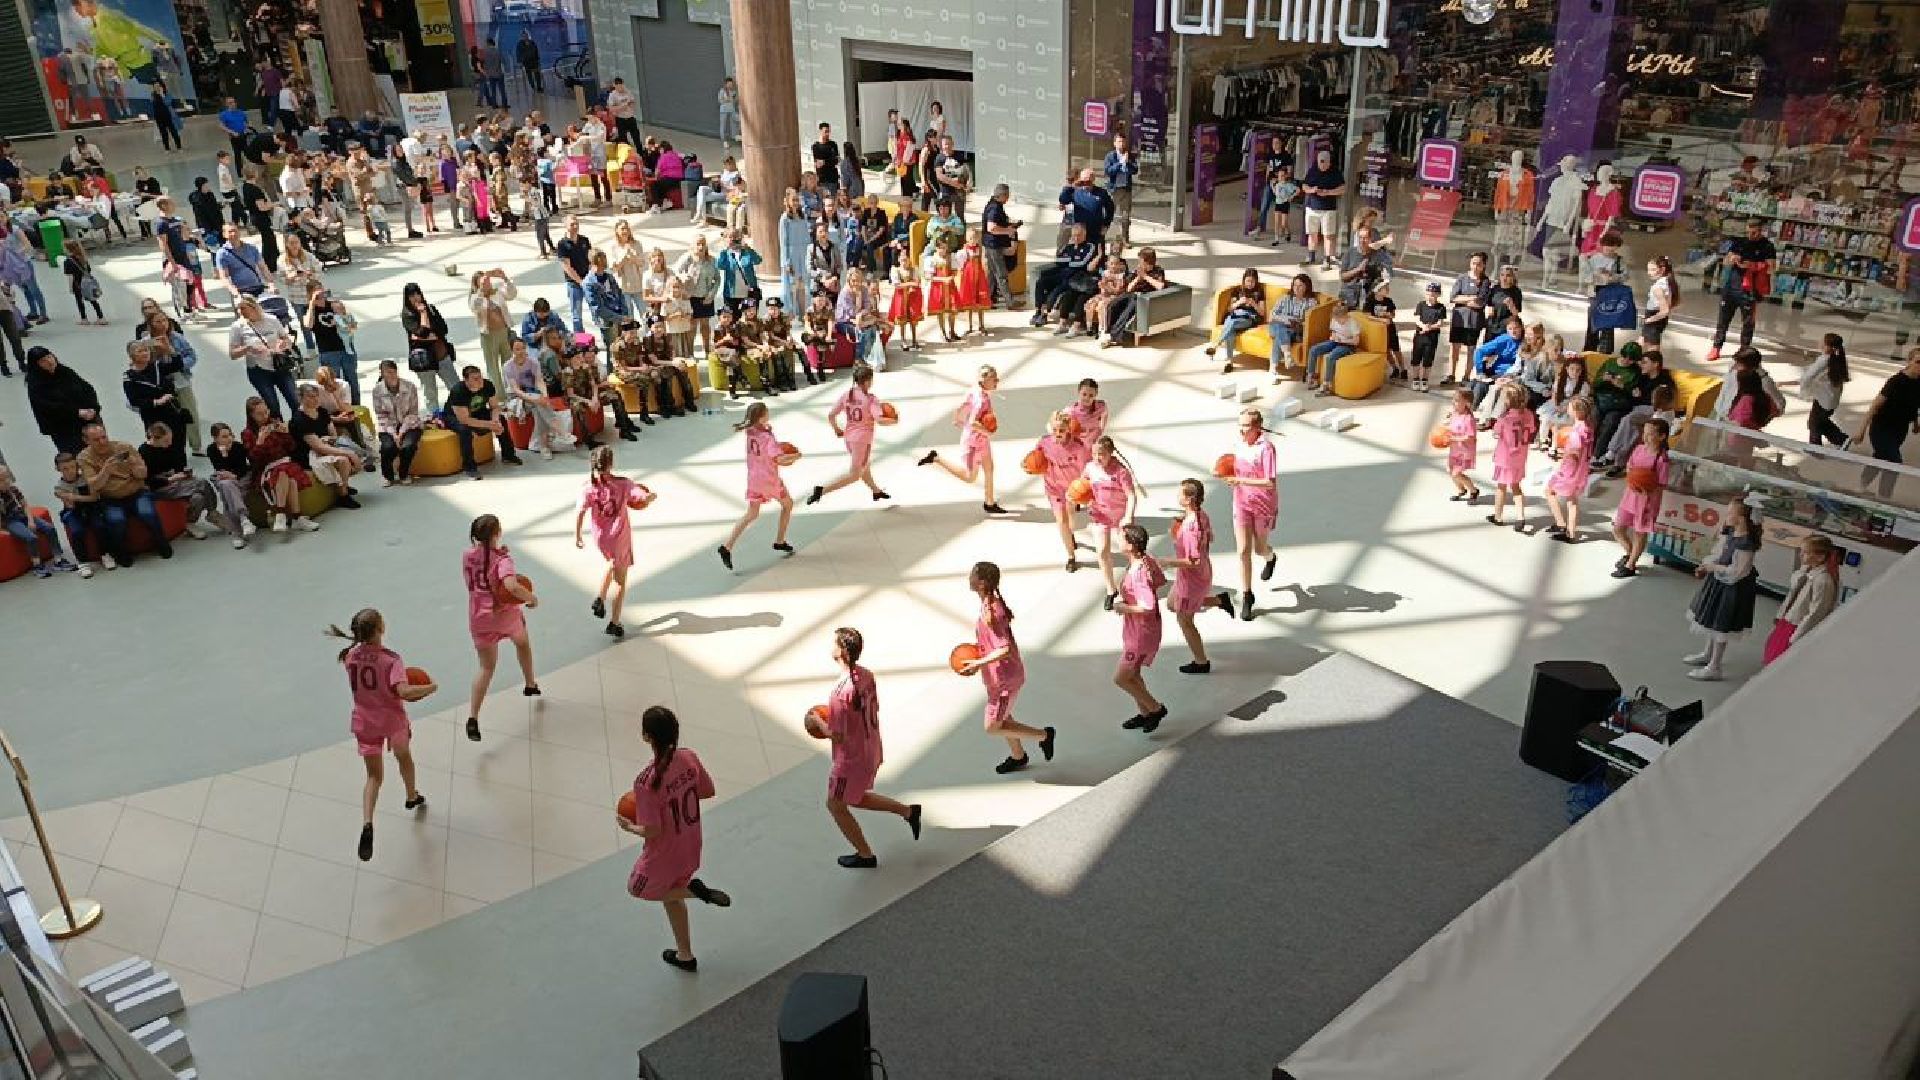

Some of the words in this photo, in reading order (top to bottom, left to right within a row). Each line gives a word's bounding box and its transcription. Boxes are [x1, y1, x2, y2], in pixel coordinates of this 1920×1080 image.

[420, 23, 455, 35] -30%
[846, 405, 863, 422] 10
[348, 662, 377, 692] 10
[669, 785, 701, 834] 10
